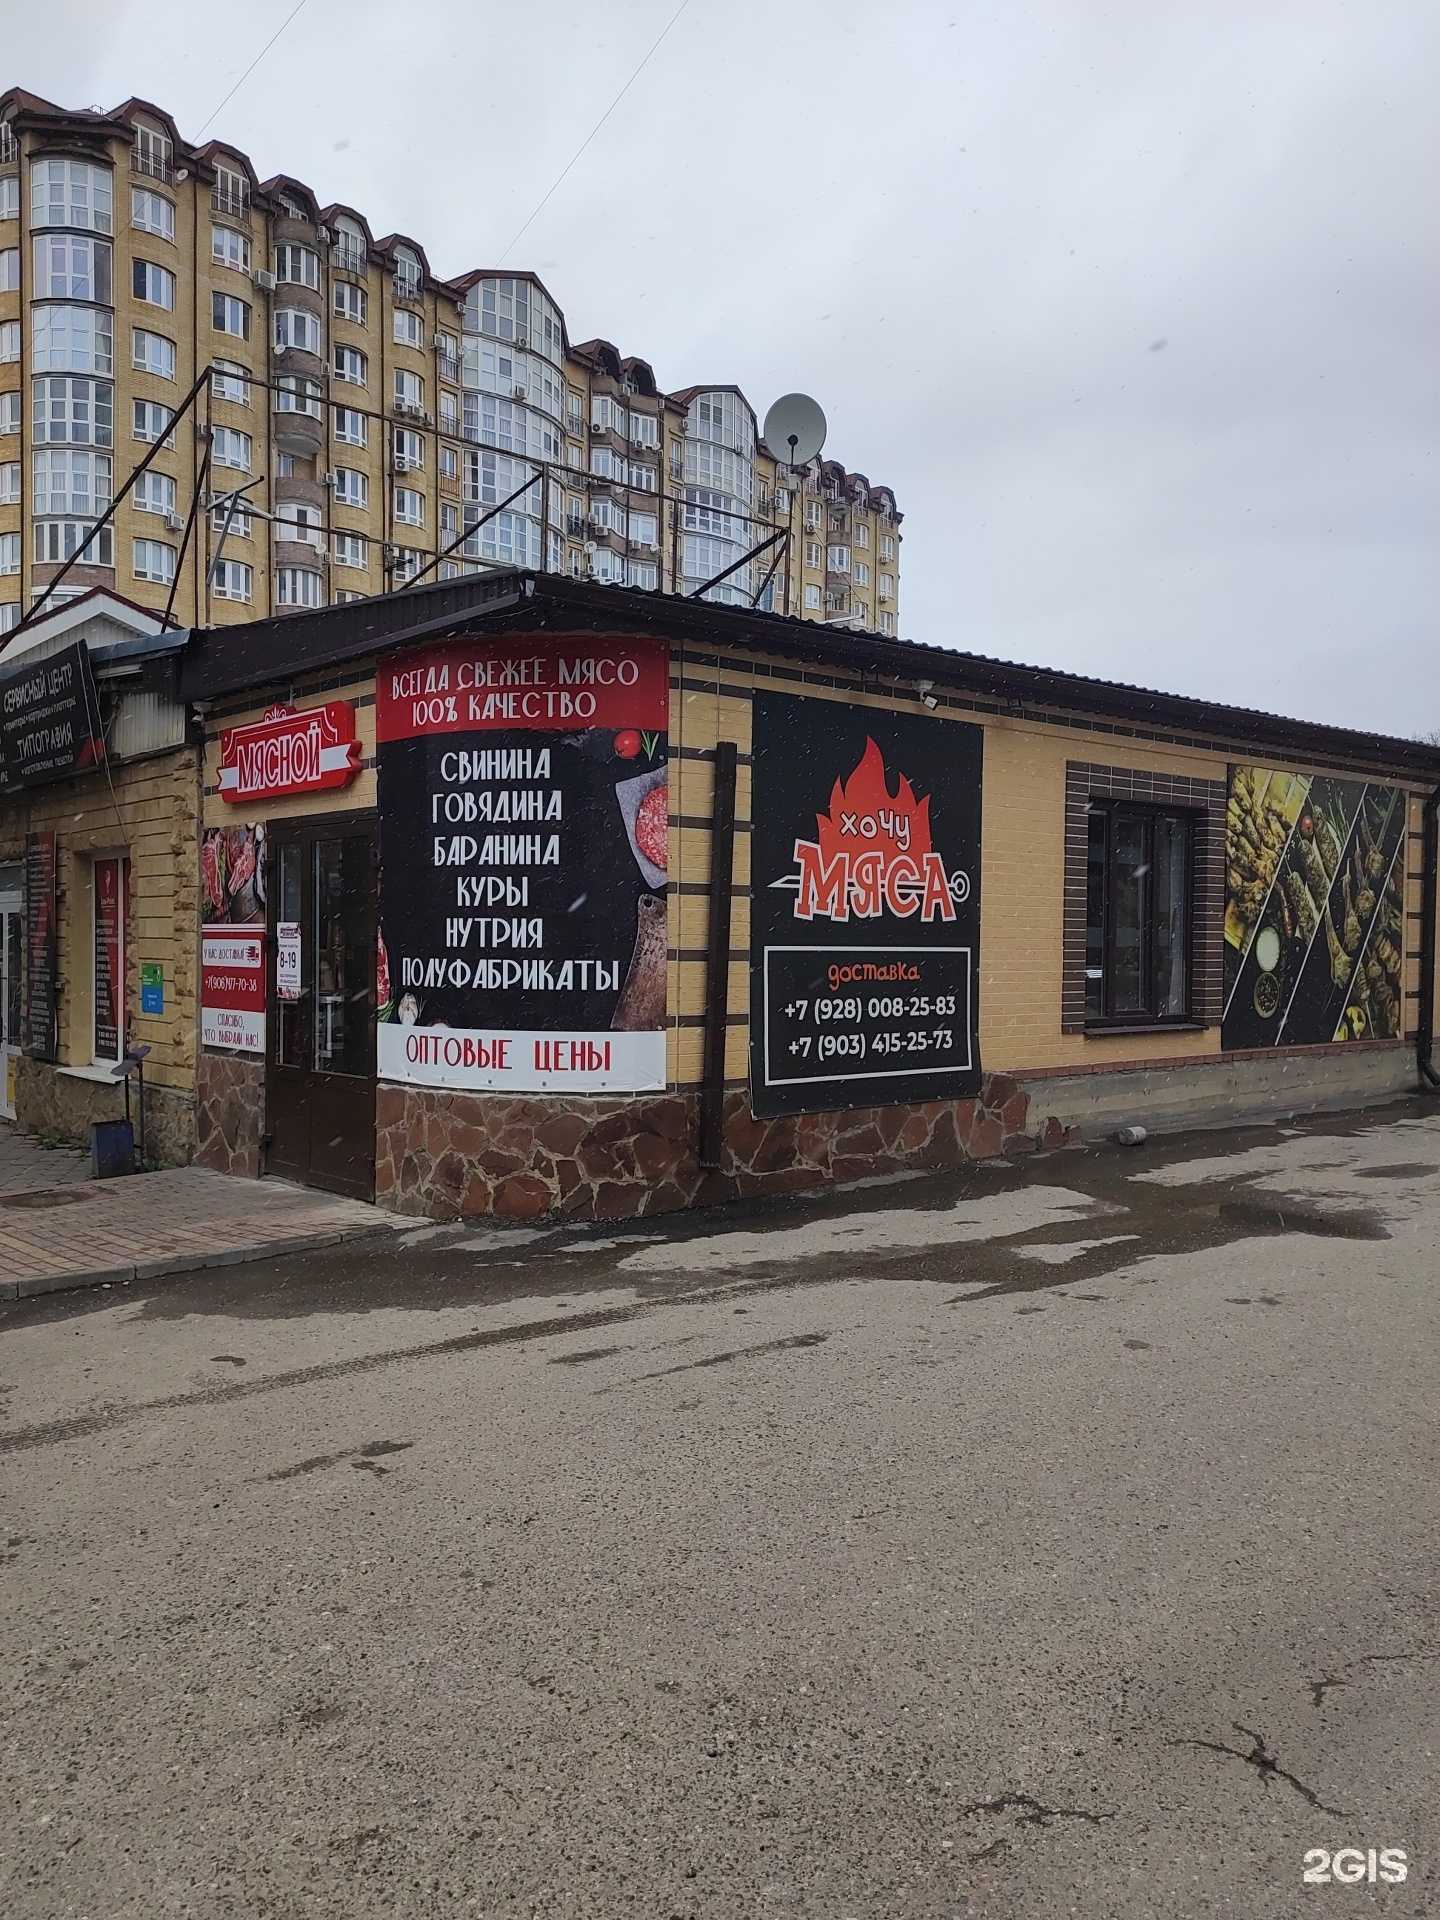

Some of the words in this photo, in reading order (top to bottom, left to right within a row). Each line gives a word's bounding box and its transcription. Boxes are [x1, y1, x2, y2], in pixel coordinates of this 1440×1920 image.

[4, 669, 47, 713] СЕРВИСНЫЙ
[49, 663, 73, 697] ЦЕНТР
[392, 664, 449, 700] ВСЕГДА
[457, 658, 547, 688] СВЕЖЕЕ
[558, 658, 639, 686] МЯСО
[412, 695, 458, 727] 100%
[468, 692, 597, 720] КАЧЕСТВО
[17, 721, 74, 761] ТИПОГРАФИЯ
[237, 721, 321, 793] МЯСНОЙ
[441, 749, 551, 782] СВИНИНА
[432, 790, 562, 823] ГОВЯДИНА
[434, 835, 560, 866] БАРАНИНА
[457, 876, 528, 907] КУРЫ
[793, 839, 957, 922] МЯСА
[446, 918, 543, 948] НУТРИЯ
[280, 951, 296, 969] 8-19
[402, 958, 619, 991] ПОЛУФАБРИКАТЫ
[828, 963, 921, 991] доставка
[784, 1000, 808, 1021] +7
[814, 998, 862, 1024] (928)
[868, 996, 956, 1019] 008-25-83
[406, 1034, 513, 1070] ОПТОВЫЕ
[534, 1040, 611, 1072] ЦЕНЫ
[788, 1037, 812, 1059] +7
[818, 1034, 866, 1061] (903)
[871, 1030, 953, 1054] 415-25-73
